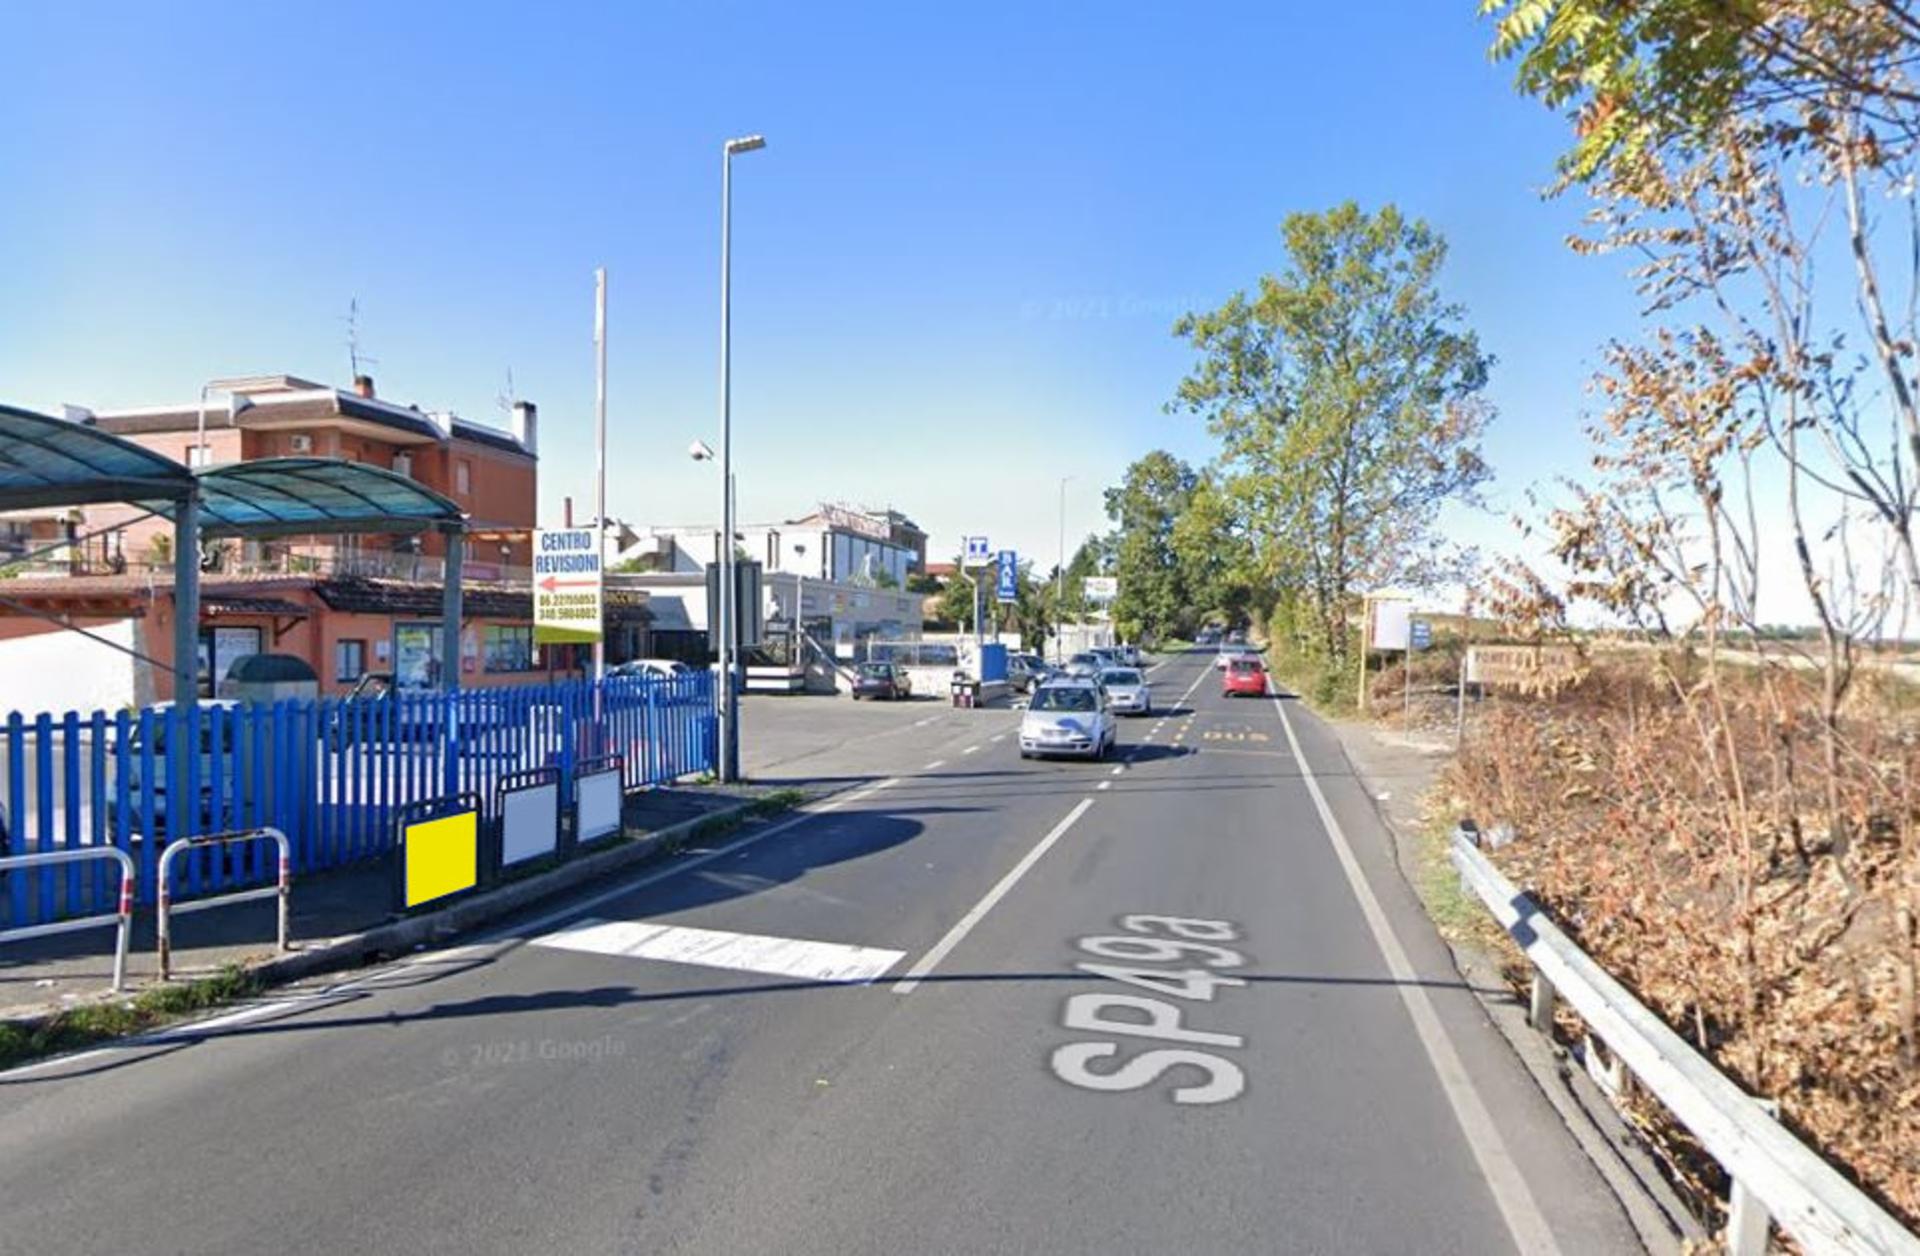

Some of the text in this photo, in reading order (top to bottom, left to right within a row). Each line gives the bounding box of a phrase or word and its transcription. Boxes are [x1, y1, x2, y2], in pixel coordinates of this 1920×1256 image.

[542, 531, 591, 551] CENTRO
[536, 554, 599, 573] REVISIONI
[1001, 551, 1014, 588] BAR
